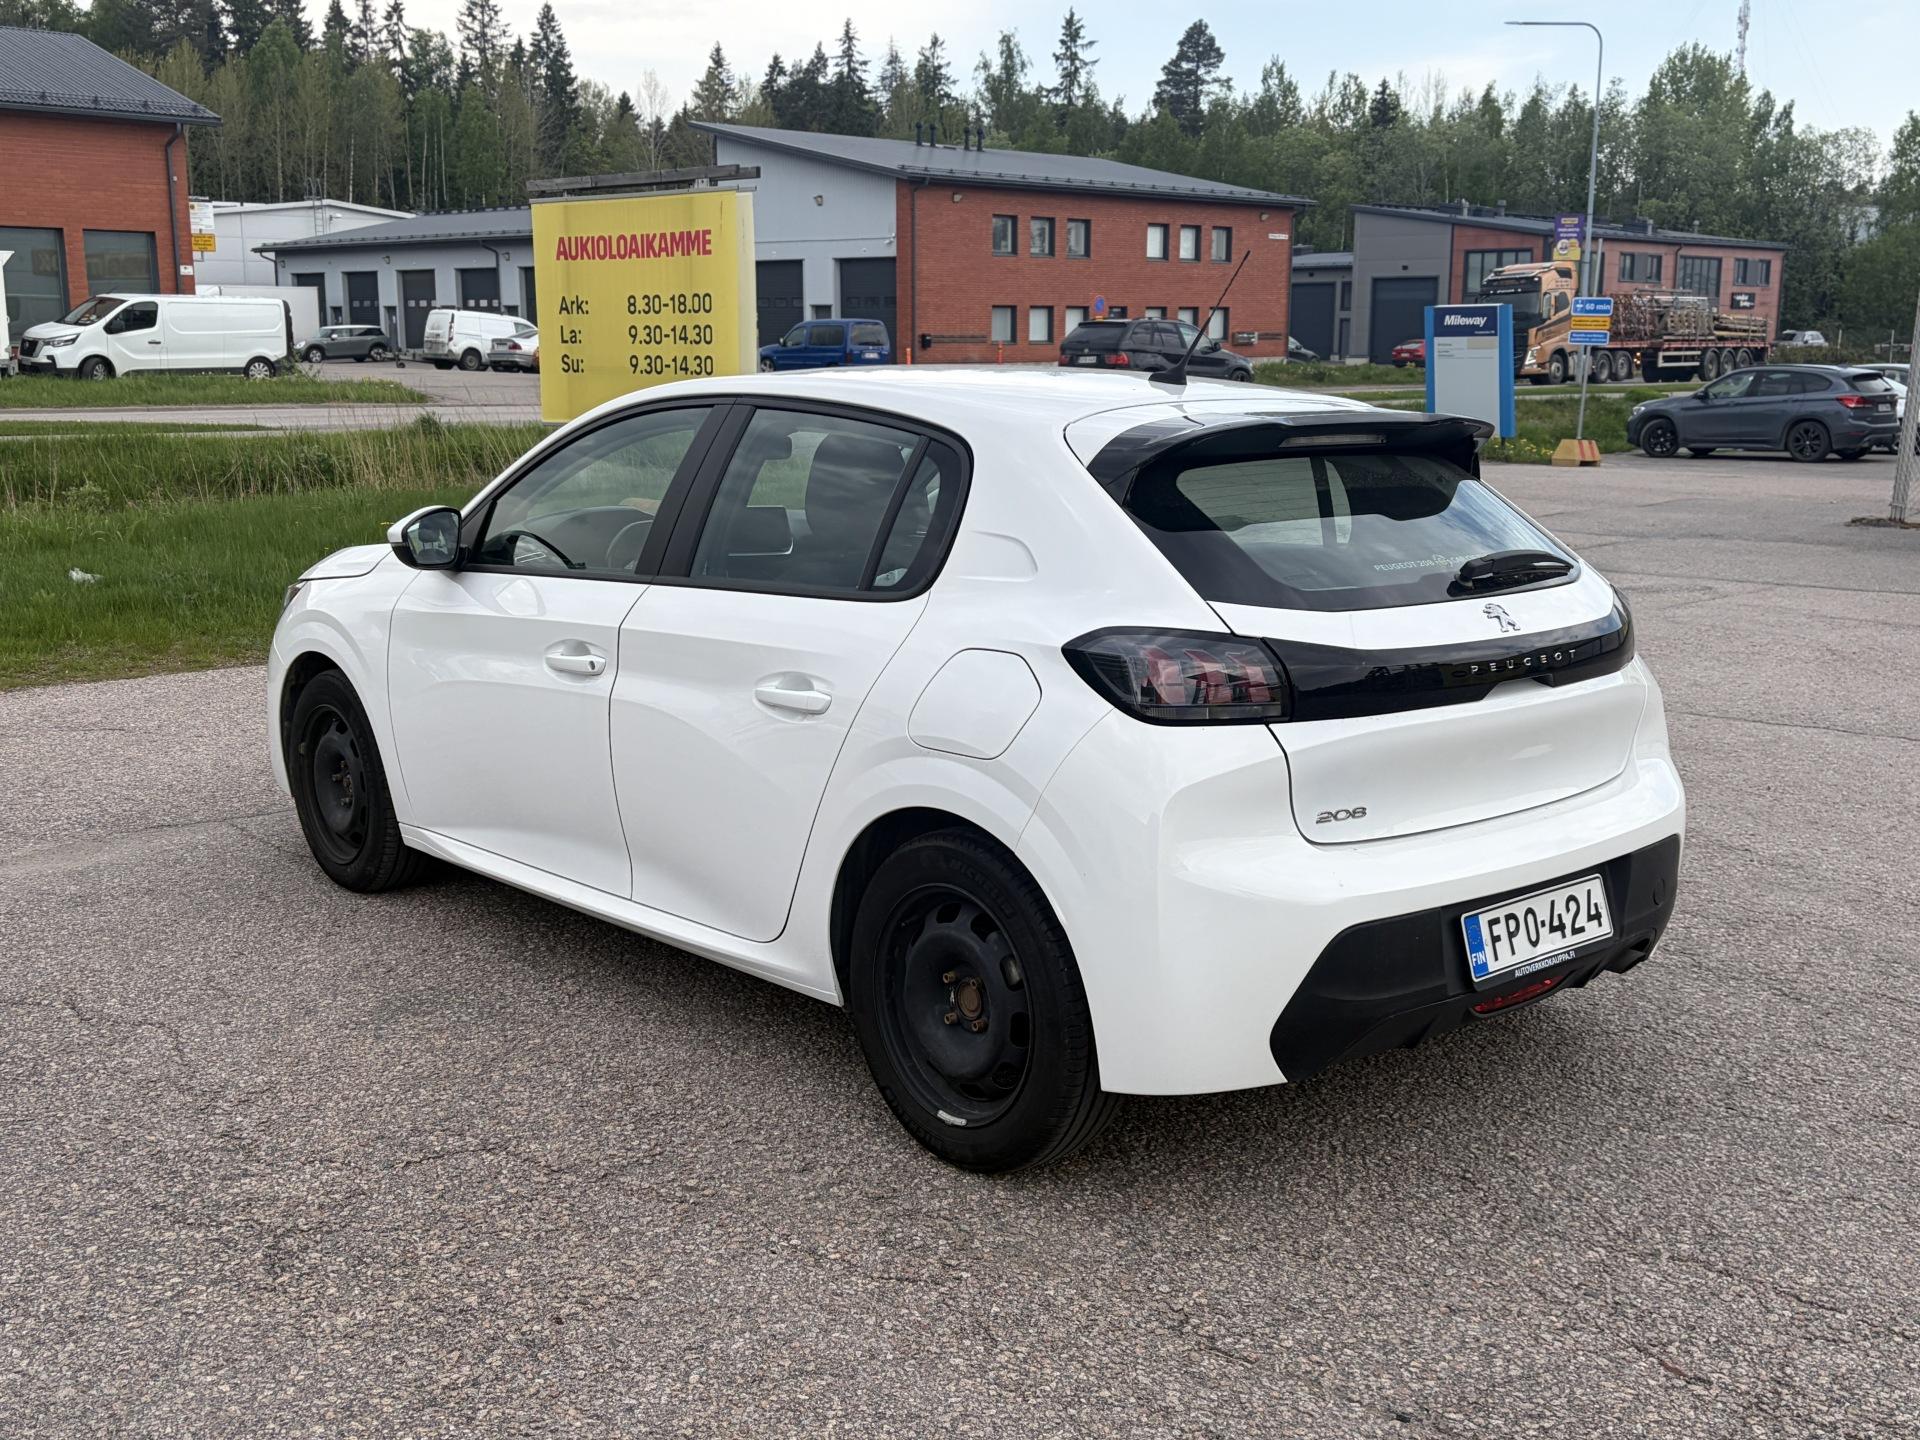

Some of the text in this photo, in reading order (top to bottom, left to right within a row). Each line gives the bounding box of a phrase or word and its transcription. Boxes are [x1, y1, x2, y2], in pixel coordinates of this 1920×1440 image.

[556, 229, 712, 261] AUKIOLOAIKAMME
[559, 293, 713, 315] Ark: 8.30-18.00
[1444, 315, 1487, 327] Mileway
[560, 324, 713, 345] La: 9.30-14.30
[561, 354, 714, 376] Su: 9.30-14.30
[1374, 560, 1415, 571] PEUGEOT
[1419, 559, 1433, 567] 208
[1470, 649, 1576, 674] PEUGEOT
[1316, 807, 1367, 824] 208
[1487, 889, 1603, 962] FPO-424
[1471, 951, 1486, 966] FIN
[1514, 952, 1576, 978] AUTOVERKKOKAUPPA.FI
